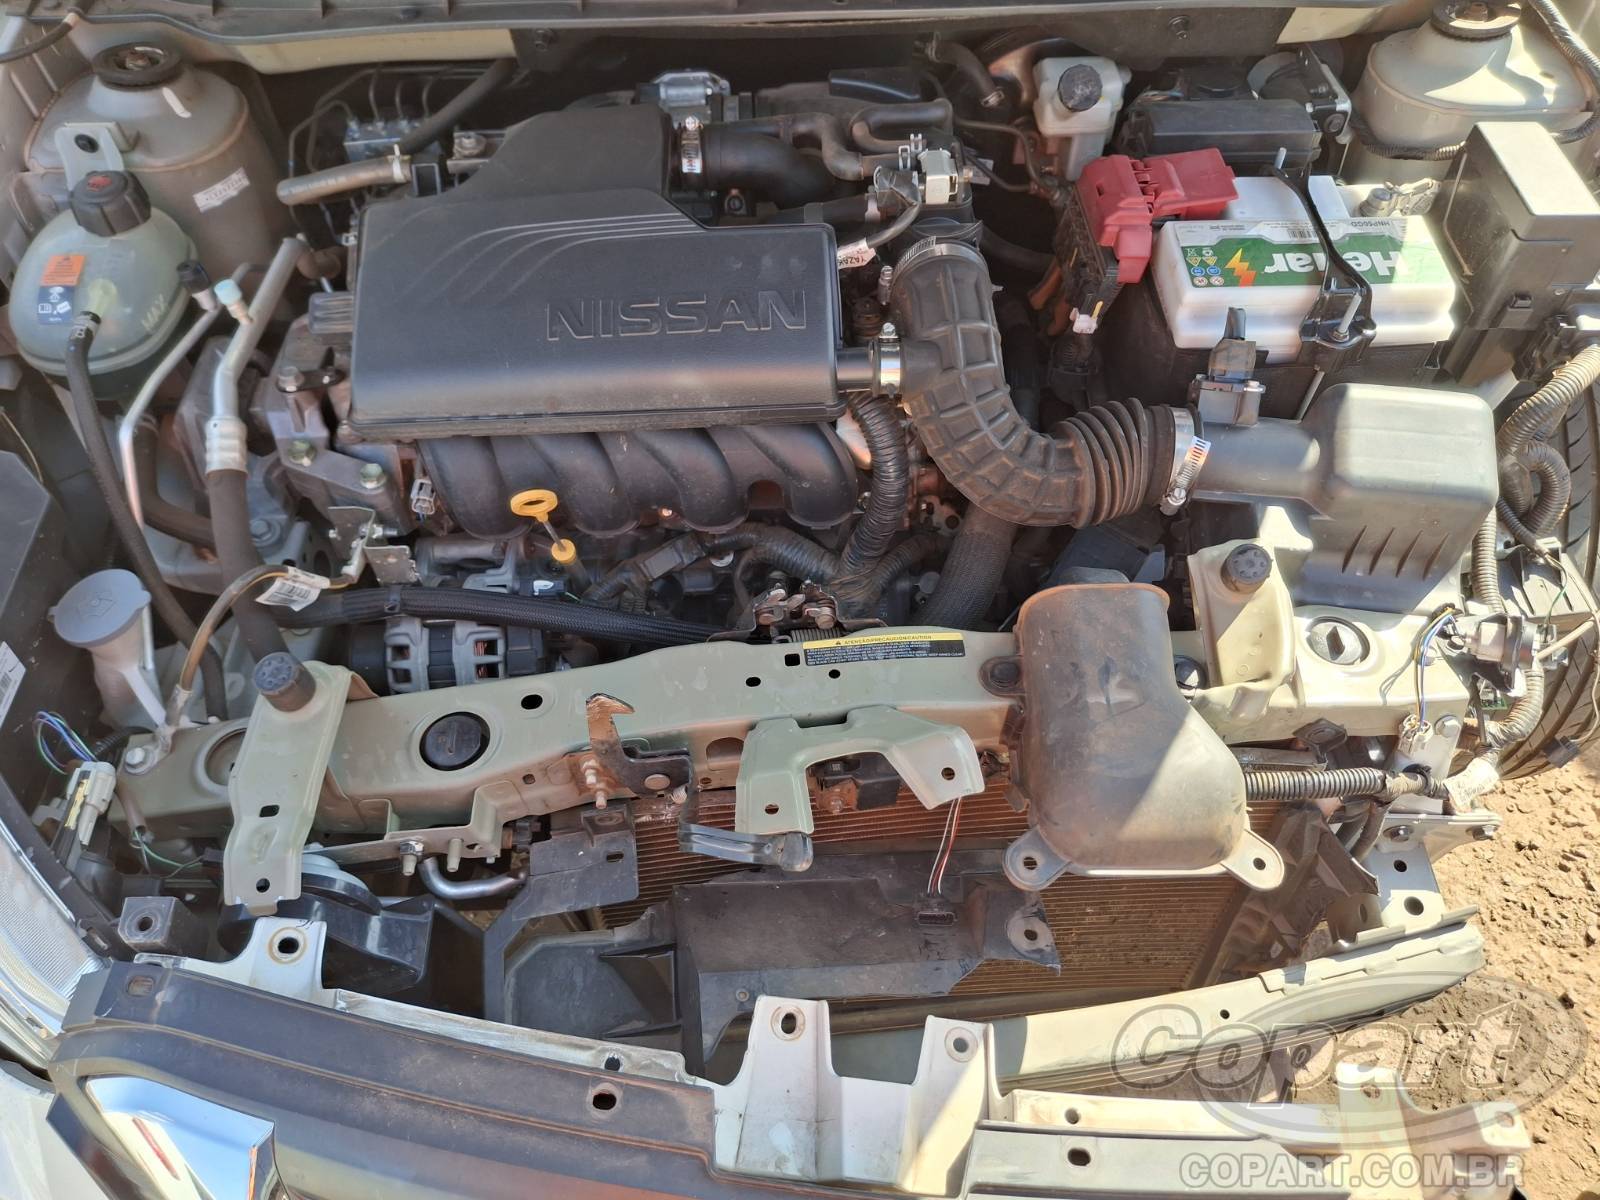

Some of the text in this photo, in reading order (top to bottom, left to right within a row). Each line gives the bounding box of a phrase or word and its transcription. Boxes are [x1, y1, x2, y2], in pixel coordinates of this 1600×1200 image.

[837, 256, 865, 267] YAZAK
[1264, 250, 1407, 276] Heiar
[546, 288, 808, 342] NISSAN
